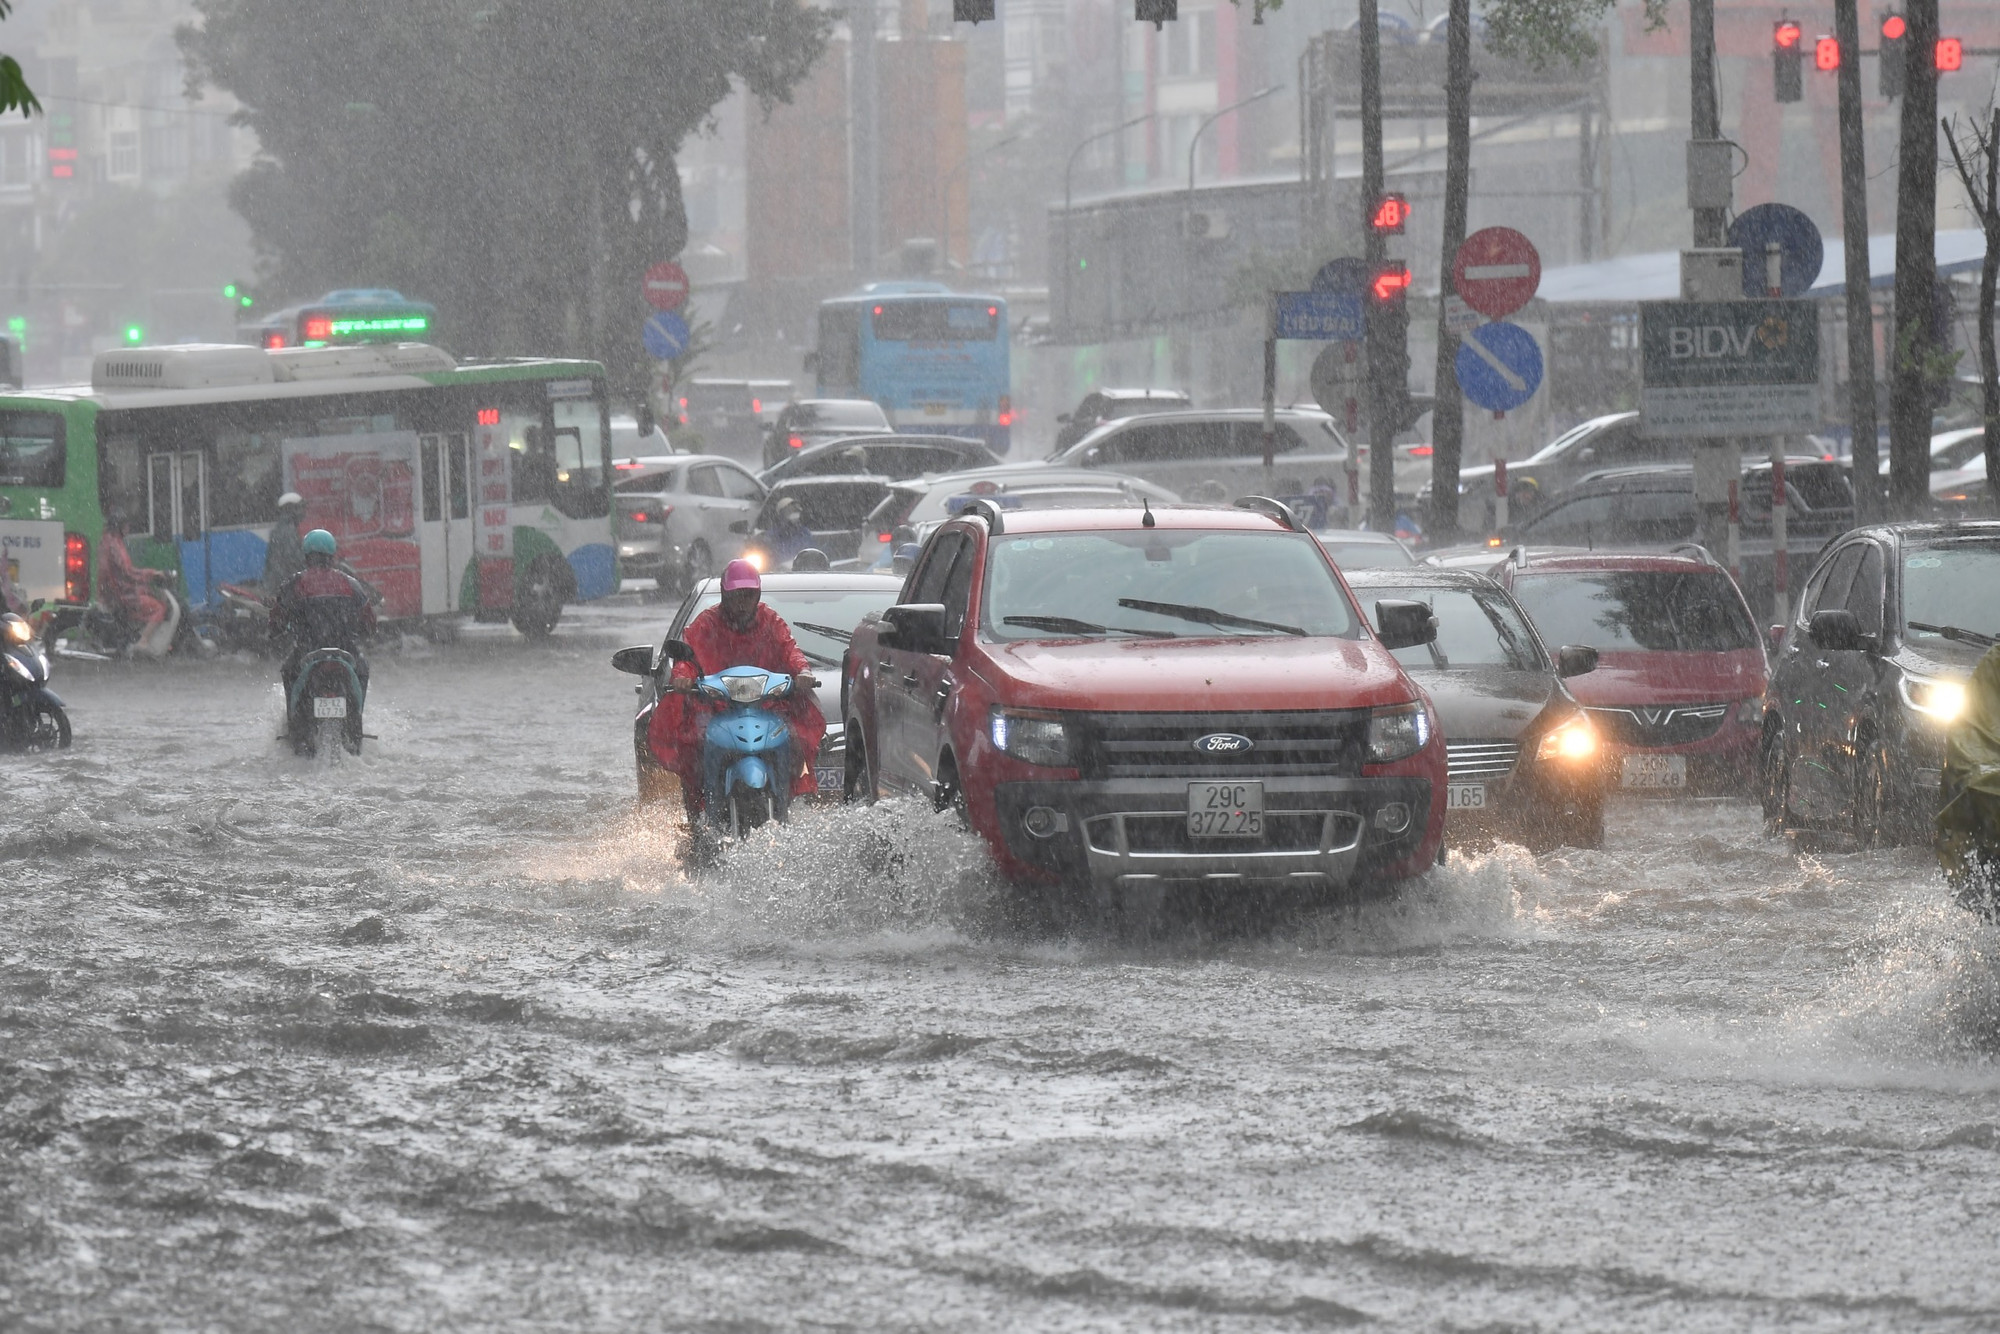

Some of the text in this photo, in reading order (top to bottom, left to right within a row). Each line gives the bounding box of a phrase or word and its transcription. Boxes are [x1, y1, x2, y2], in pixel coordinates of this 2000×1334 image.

[1669, 325, 1756, 358] BIDV
[23, 536, 41, 549] BUS
[1207, 736, 1241, 750] Ford
[1206, 785, 1246, 808] 29C
[1191, 810, 1261, 834] 372.25
